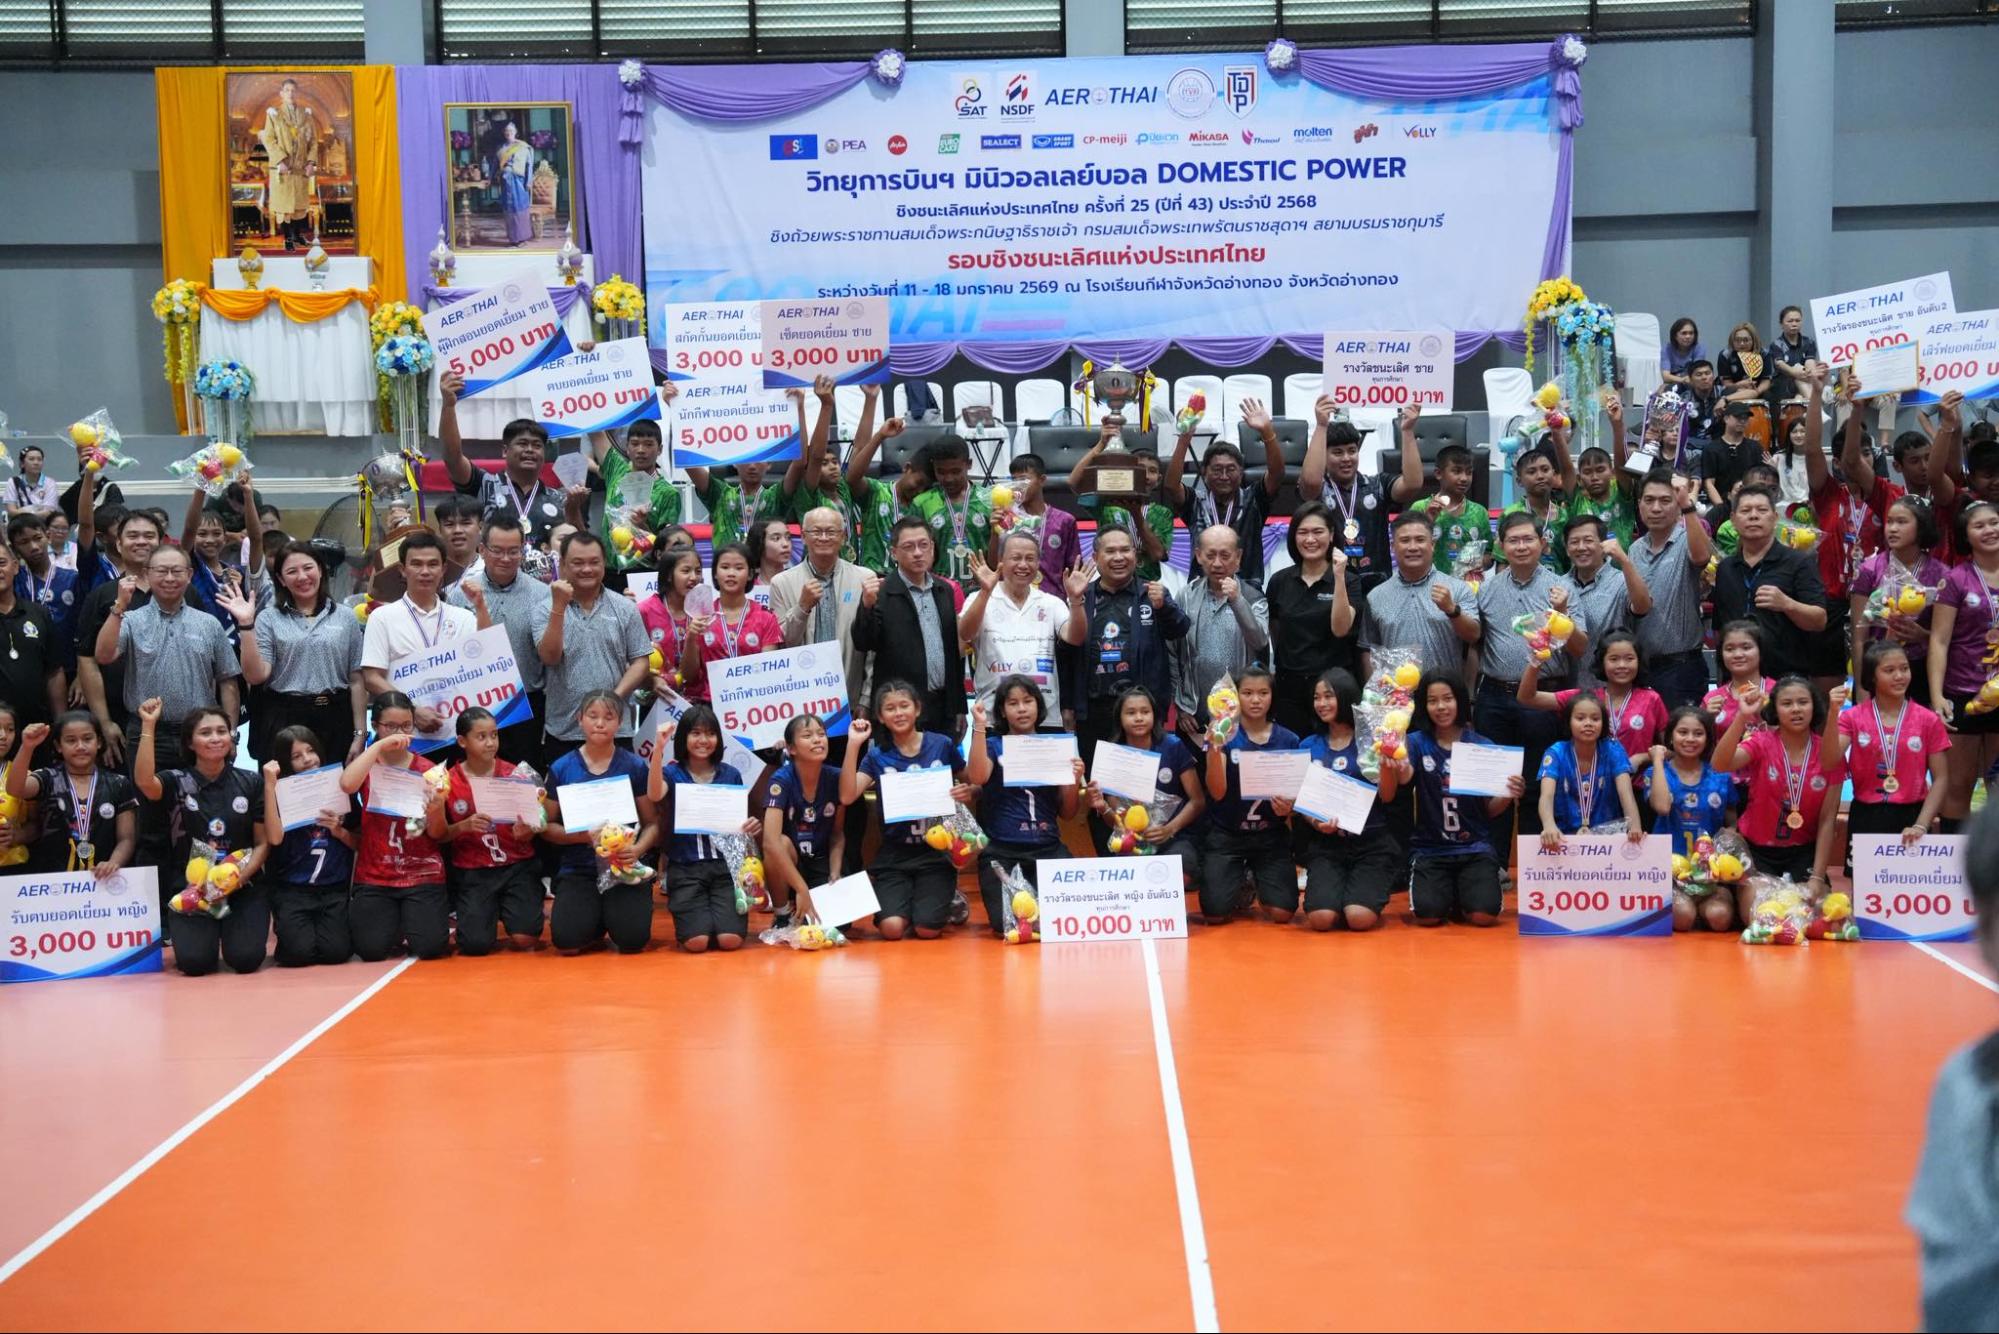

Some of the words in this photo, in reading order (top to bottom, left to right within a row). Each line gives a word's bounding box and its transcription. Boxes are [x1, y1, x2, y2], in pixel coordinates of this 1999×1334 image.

[958, 104, 987, 116] SAT
[1000, 104, 1035, 116] NSDF
[842, 139, 866, 150] PEA
[1083, 133, 1128, 146] CP-meiji
[1294, 127, 1333, 138] molten
[806, 169, 955, 199] วิทยุการบินฯ
[965, 163, 1147, 189] มินิวอลเลย์บอล
[1158, 159, 1297, 184] DOMESTIC
[1307, 156, 1407, 180] POWER
[896, 200, 1079, 218] ชิงชนะเลิศแห่งประเทศไทย
[1085, 195, 1125, 213] ครั้งที่
[1130, 199, 1150, 212] 25
[1155, 193, 1182, 214] (ปีที่
[1187, 197, 1214, 213] 43)
[1218, 193, 1271, 211] ประจำปี
[1276, 195, 1317, 209] 2568
[1313, 213, 1446, 232] สยามบรมราชกุมารี
[948, 243, 1266, 270] รอบชิงชนะเลิศแห่งประเทศไทย
[817, 279, 899, 298] ระหว่างวันที่
[904, 284, 918, 296] 11
[934, 283, 951, 296] 18
[956, 281, 1014, 296] มกราคม
[1020, 280, 1059, 294] 2569
[1065, 281, 1081, 294] ณ
[1288, 272, 1399, 288] จังหวัดอ่างทอง
[449, 336, 515, 376] 5,000
[520, 322, 557, 347] บาท
[675, 349, 743, 371] 3,000
[771, 346, 839, 369] 3,000
[846, 347, 883, 364] บาท
[541, 391, 607, 419] 3,000
[614, 386, 651, 406] บาท
[768, 403, 789, 414] ชาย
[1334, 385, 1408, 408] 50,000
[1411, 390, 1444, 404] บาท
[681, 424, 748, 449] 5,000
[756, 422, 792, 440] บาท
[814, 671, 840, 687] หญิง
[476, 682, 517, 708] บาท
[724, 702, 794, 733] 5,000
[803, 696, 842, 716] บาท
[1442, 797, 1460, 831] 6
[388, 821, 404, 854] 4
[482, 834, 508, 863] 8
[310, 848, 327, 884] 7
[1637, 868, 1667, 883] หญิง
[117, 901, 148, 919] หญิง
[1528, 891, 1610, 915] 3,000
[1619, 895, 1664, 911] บาท
[1865, 894, 1952, 919] 3,000
[1051, 915, 1132, 939] 10,000
[1139, 917, 1175, 933] บาท
[9, 929, 97, 960] 3,000
[106, 928, 153, 950] บาท
